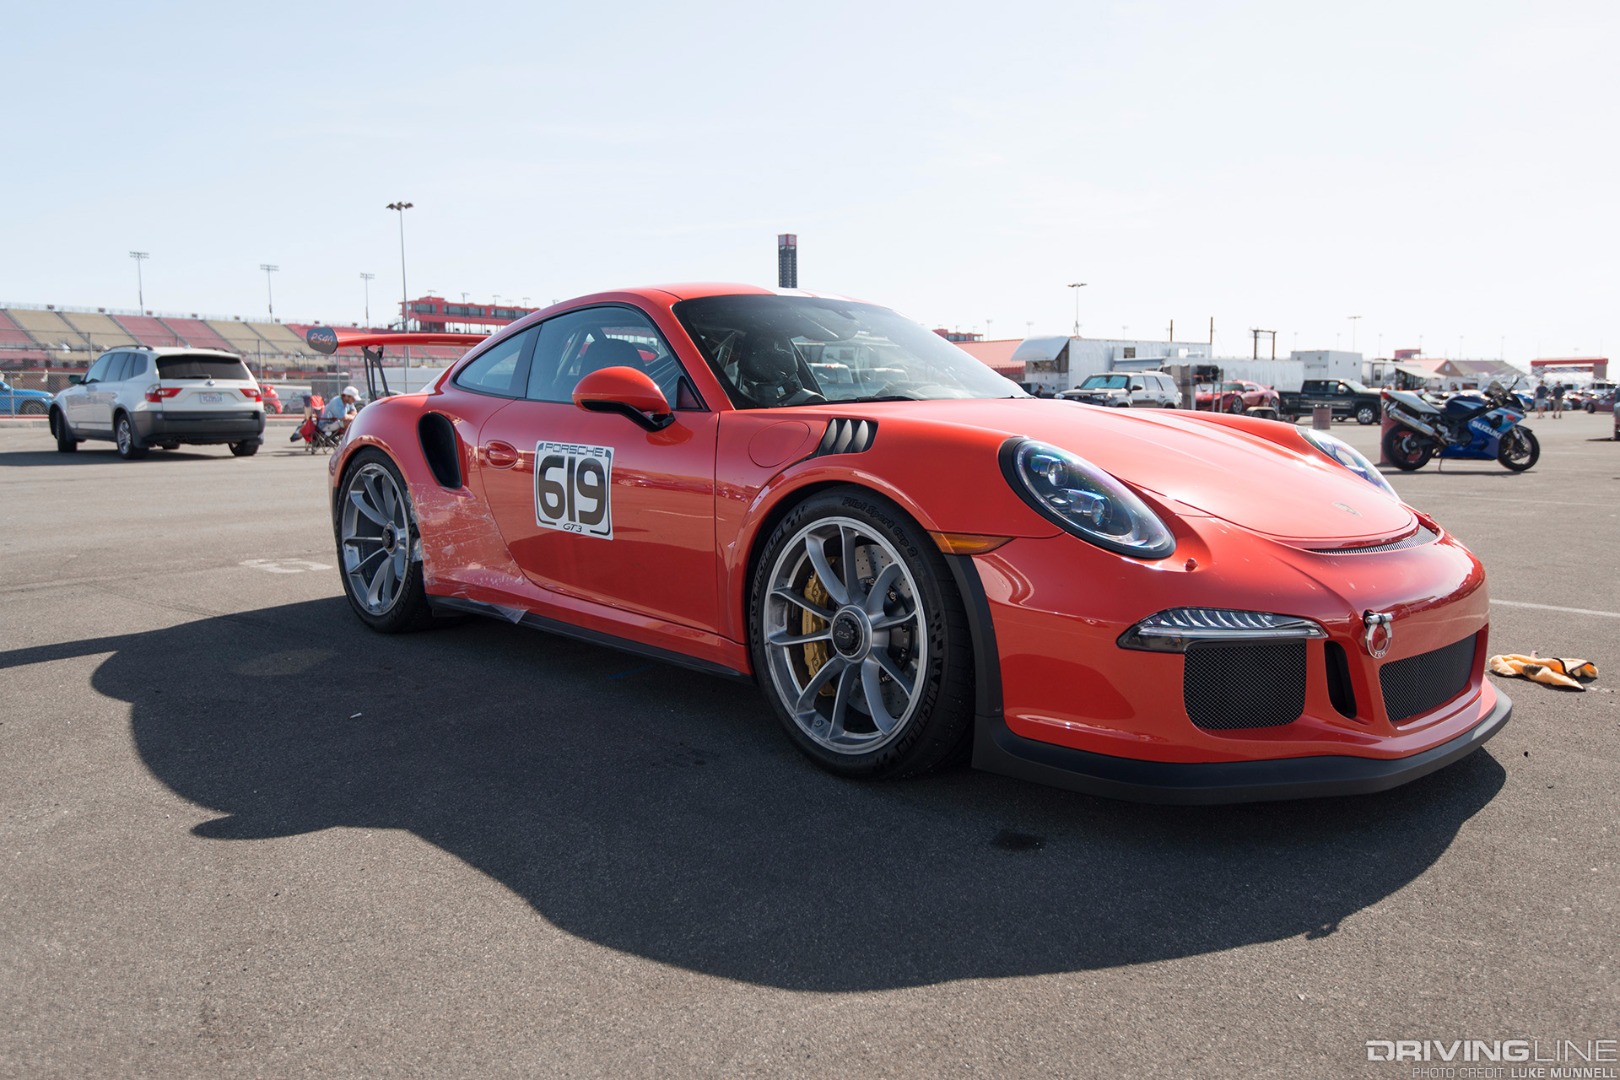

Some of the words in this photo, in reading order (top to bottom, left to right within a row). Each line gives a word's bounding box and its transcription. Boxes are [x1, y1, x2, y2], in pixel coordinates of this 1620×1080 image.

[544, 442, 604, 457] PORSCHE
[1471, 420, 1503, 440] SUZUKI
[538, 454, 607, 526] 619
[841, 496, 869, 512] Pilot
[866, 505, 896, 530] Sport
[907, 546, 919, 558] 2
[752, 526, 784, 596] MICHELIN
[835, 629, 851, 640] RS
[896, 680, 940, 758] MICHELIN
